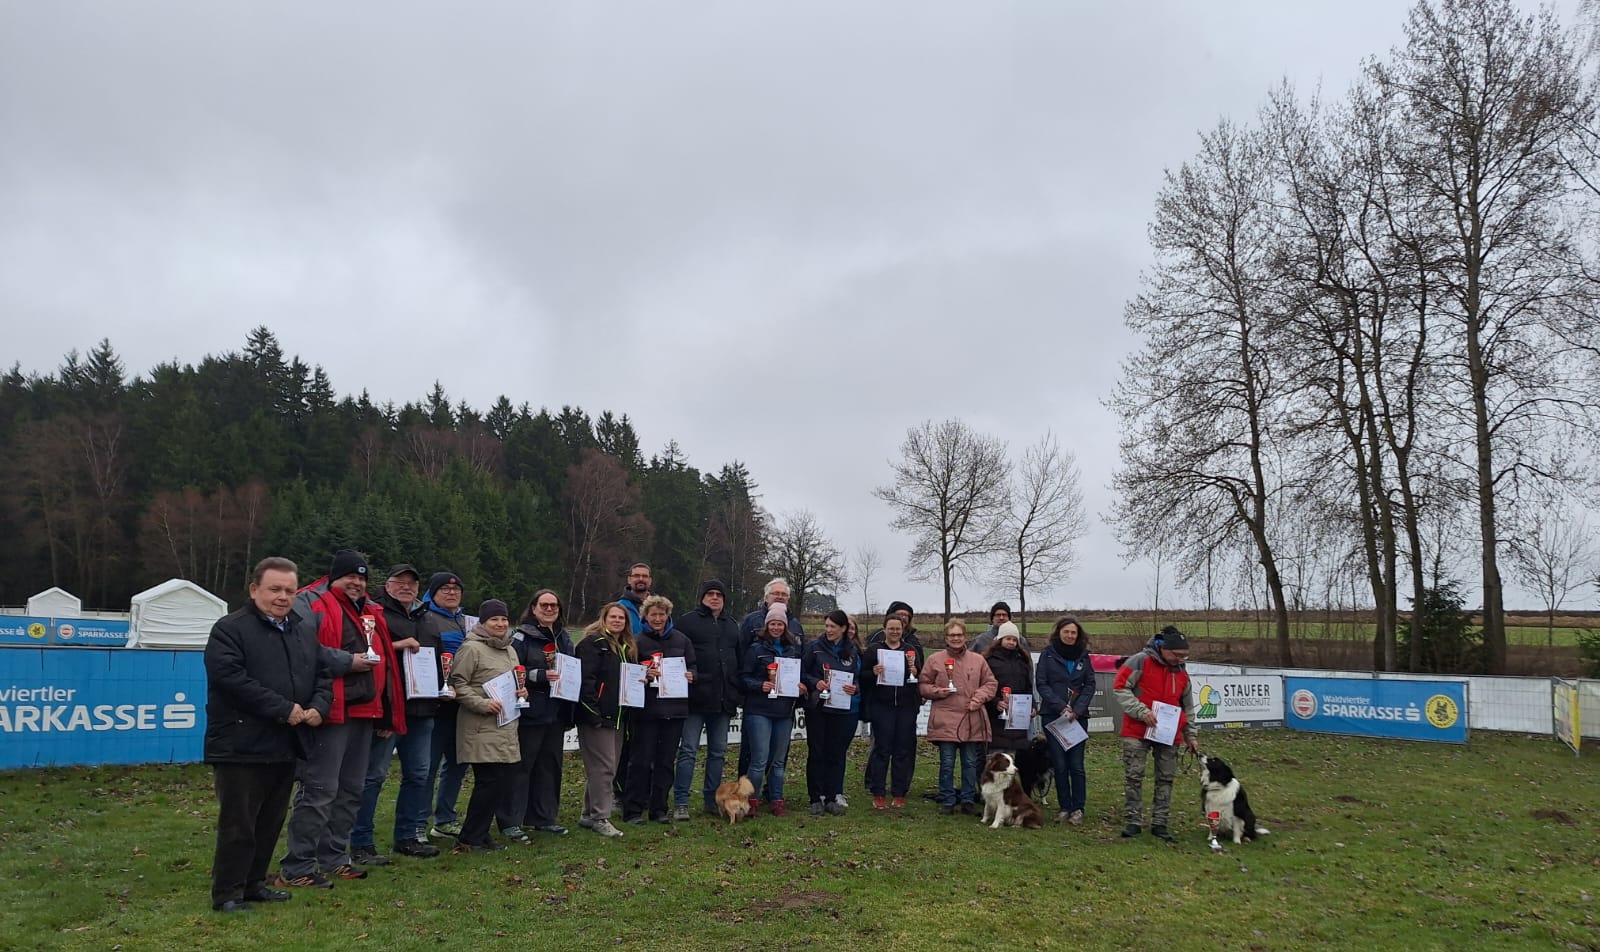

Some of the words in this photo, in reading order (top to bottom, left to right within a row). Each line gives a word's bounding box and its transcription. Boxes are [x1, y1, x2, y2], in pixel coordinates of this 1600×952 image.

[78, 631, 123, 639] SPARKASSE
[1223, 684, 1270, 697] STAUFER
[1224, 697, 1271, 707] SONNENSCHUTZ
[1322, 695, 1371, 704] Waldviertler
[1322, 703, 1403, 720] SPARKASSE
